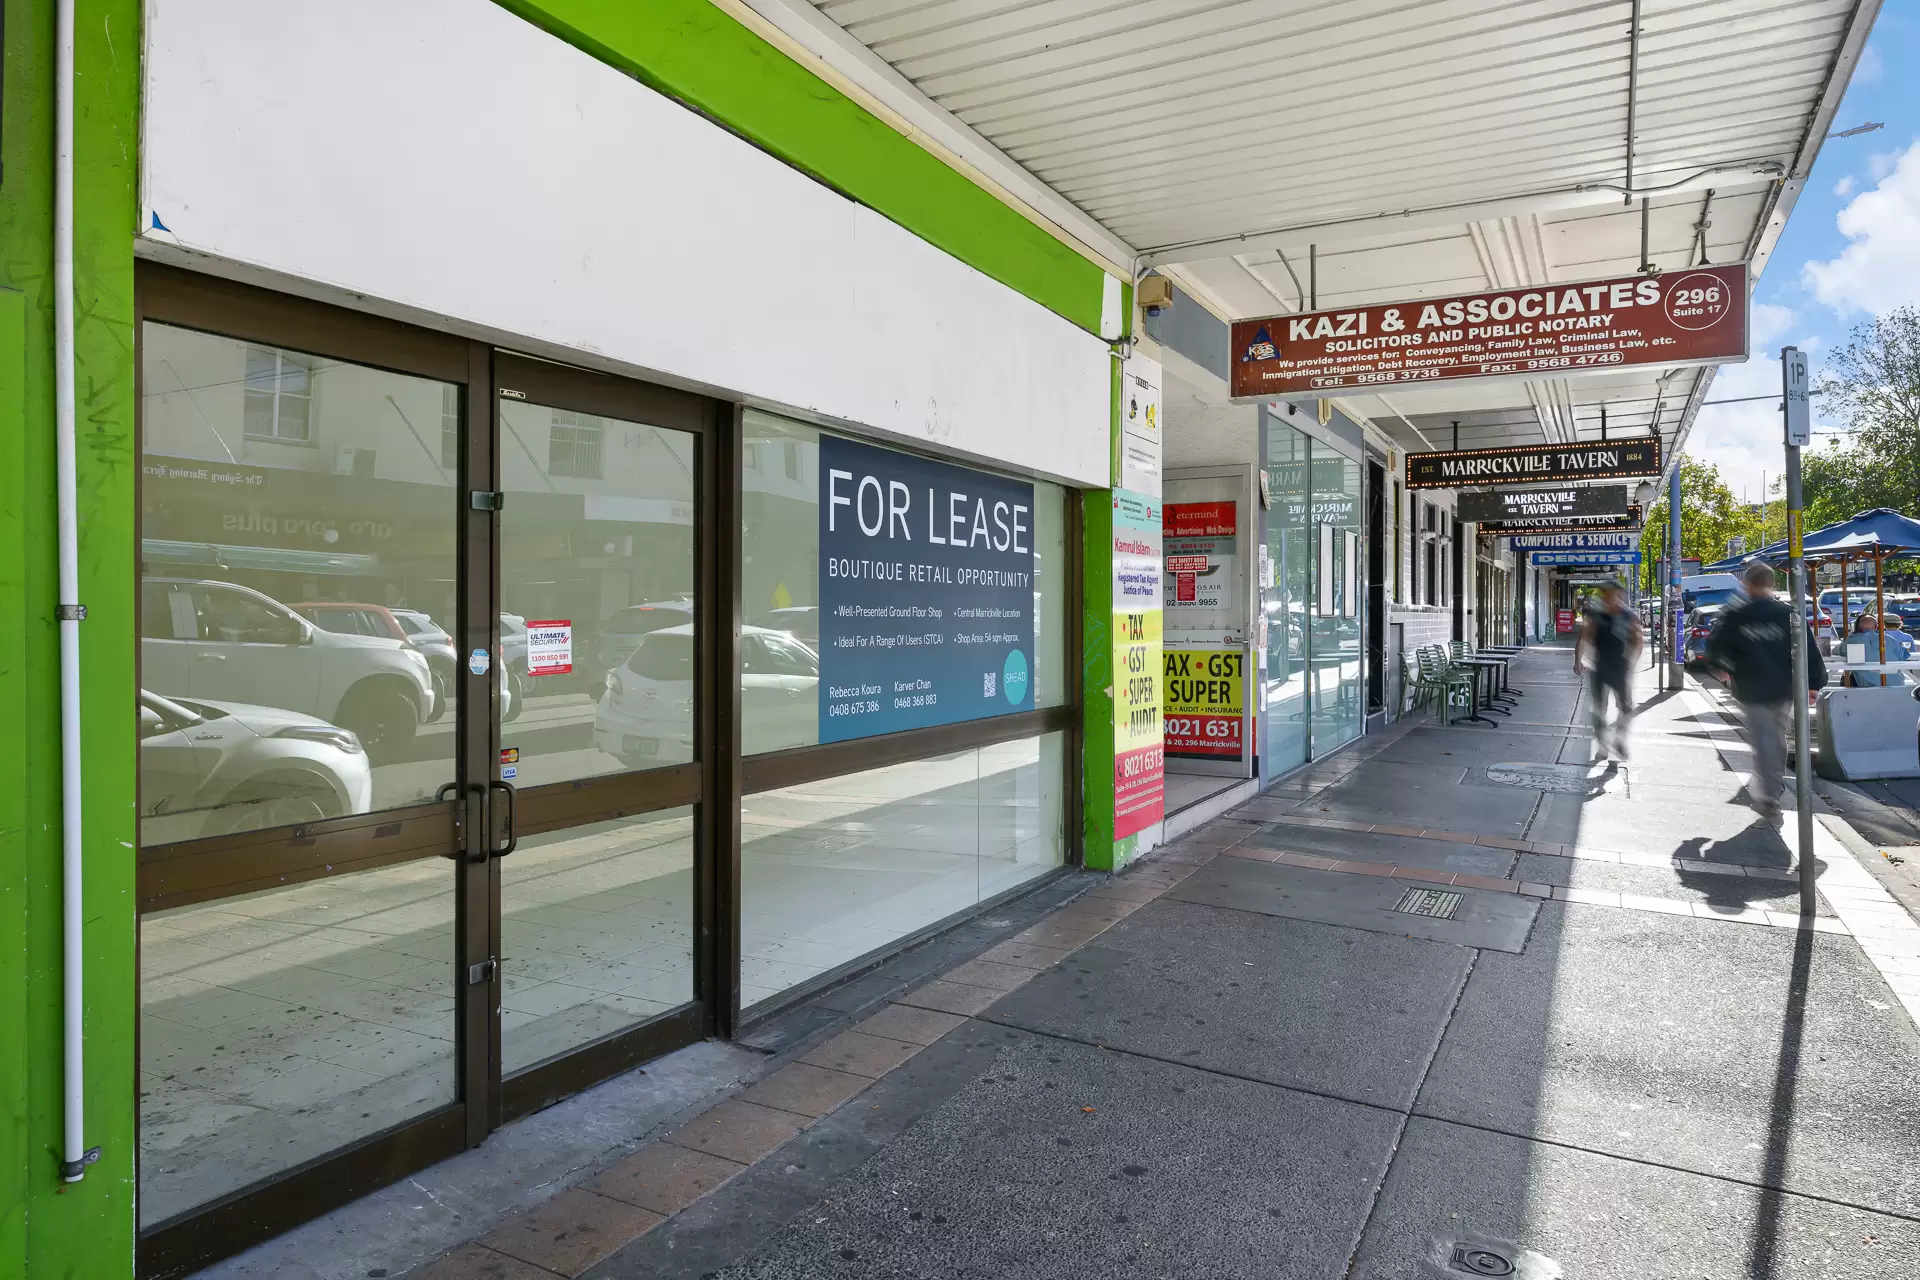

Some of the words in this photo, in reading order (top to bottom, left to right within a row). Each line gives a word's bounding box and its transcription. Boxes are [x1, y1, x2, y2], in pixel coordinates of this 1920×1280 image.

[1674, 287, 1720, 306] 296
[1289, 312, 1368, 342] KAZI
[1380, 308, 1406, 332] &
[1417, 279, 1661, 328] ASSOCIATES
[1673, 307, 1704, 318] Suite
[1707, 304, 1722, 314] 17
[1325, 333, 1423, 353] SOLICITORS
[1428, 329, 1464, 344] AND
[1468, 321, 1533, 340] PUBLIC
[1539, 314, 1615, 332] NOTARY
[1279, 359, 1295, 369] We
[1296, 356, 1334, 369] provide
[1336, 351, 1379, 364] services
[1381, 350, 1400, 360] for:
[1405, 341, 1485, 359] Conveyancing,
[1486, 337, 1526, 350] Family
[1528, 335, 1557, 347] Law,
[1559, 330, 1609, 343] Criminal
[1612, 327, 1642, 340] Law,
[1262, 367, 1321, 380] Immigration
[1323, 363, 1376, 377] Litigation,
[1377, 361, 1403, 370] Debt
[1405, 354, 1459, 369] Recovery,
[1461, 348, 1531, 364] Employment
[1534, 345, 1559, 358] law,
[1561, 341, 1616, 354] Business
[1619, 338, 1649, 350] Law,
[1651, 336, 1677, 346] etc.
[1314, 377, 1344, 387] Tel:
[1357, 372, 1396, 383] 9568
[1400, 367, 1440, 380] 3736
[1480, 363, 1517, 373] Fax:
[1527, 356, 1571, 369] 9568
[1576, 353, 1622, 365] 4746
[1790, 362, 1805, 384] 1P
[1421, 465, 1434, 474] EST.
[1441, 455, 1551, 477] MARRICKVILLE
[1558, 450, 1619, 470] TAVERN
[1625, 452, 1643, 462] 1884
[1504, 491, 1577, 505] MARRICKVILLE
[829, 468, 912, 541] FOR
[929, 488, 1028, 554] LEASE
[1520, 503, 1559, 515] TAVERN
[1578, 515, 1616, 525] TAVERN
[1176, 526, 1204, 536] Advertising
[1206, 526, 1217, 534] Web
[1218, 525, 1235, 535] Design
[1114, 538, 1136, 554] Kamrul
[1135, 540, 1151, 557] Islam
[1515, 534, 1573, 547] COMPUTERS
[1576, 535, 1585, 546] &
[1587, 532, 1628, 547] SERVICE
[1538, 553, 1636, 563] DENTIST
[829, 557, 903, 581] BOUTIQUE
[909, 564, 952, 584] RETAIL
[957, 567, 1029, 588] OPPORTUNITY
[1118, 571, 1140, 585] Registered
[1146, 574, 1159, 586] Agent
[1123, 584, 1137, 596] Justice
[1137, 586, 1142, 596] of
[1141, 587, 1154, 597] Peace
[1166, 599, 1176, 607] 02
[1198, 598, 1218, 606] 9955
[838, 605, 888, 618] Well-Presented
[889, 605, 911, 618] Ground
[912, 606, 926, 618] Floor
[928, 606, 943, 620] Shop
[957, 607, 975, 618] Central
[975, 607, 1002, 618] Marrickville
[1002, 608, 1021, 618] Location
[1128, 613, 1144, 641] TAX
[530, 632, 566, 640] ULTIMATE
[530, 638, 562, 646] SECURITY
[838, 635, 855, 648] Ideal
[856, 635, 868, 647] For
[869, 635, 875, 646] A
[876, 635, 896, 648] Range
[896, 634, 905, 646] Of
[905, 634, 923, 646] Users
[923, 634, 944, 646] (STCA)
[957, 633, 970, 646] Shop
[971, 633, 984, 644] Area:
[992, 634, 1002, 645] sqm
[1003, 632, 1020, 645] Approx.
[1128, 645, 1147, 674] GST
[1208, 653, 1243, 678] GST
[894, 680, 915, 692] Karver
[916, 679, 932, 690] Chan
[1005, 671, 1026, 684] SHEAD
[829, 684, 860, 699] Rebecca
[861, 683, 882, 695] Koura
[1129, 675, 1154, 706] SUPER
[1169, 679, 1231, 704] SUPER
[829, 703, 850, 717] 0408
[851, 701, 865, 714] 675
[866, 700, 880, 713] 386
[894, 696, 911, 709] 0468
[912, 694, 924, 707] 368
[925, 693, 937, 706] 883
[1179, 705, 1199, 713] AUDIT
[1130, 706, 1157, 738] AUDIT
[1205, 719, 1240, 738] 631
[1173, 739, 1184, 747] 20,
[1199, 739, 1241, 749] Marrickville
[1124, 754, 1144, 778] 8021
[1144, 747, 1164, 771] 6313
[504, 768, 516, 776] VISA
